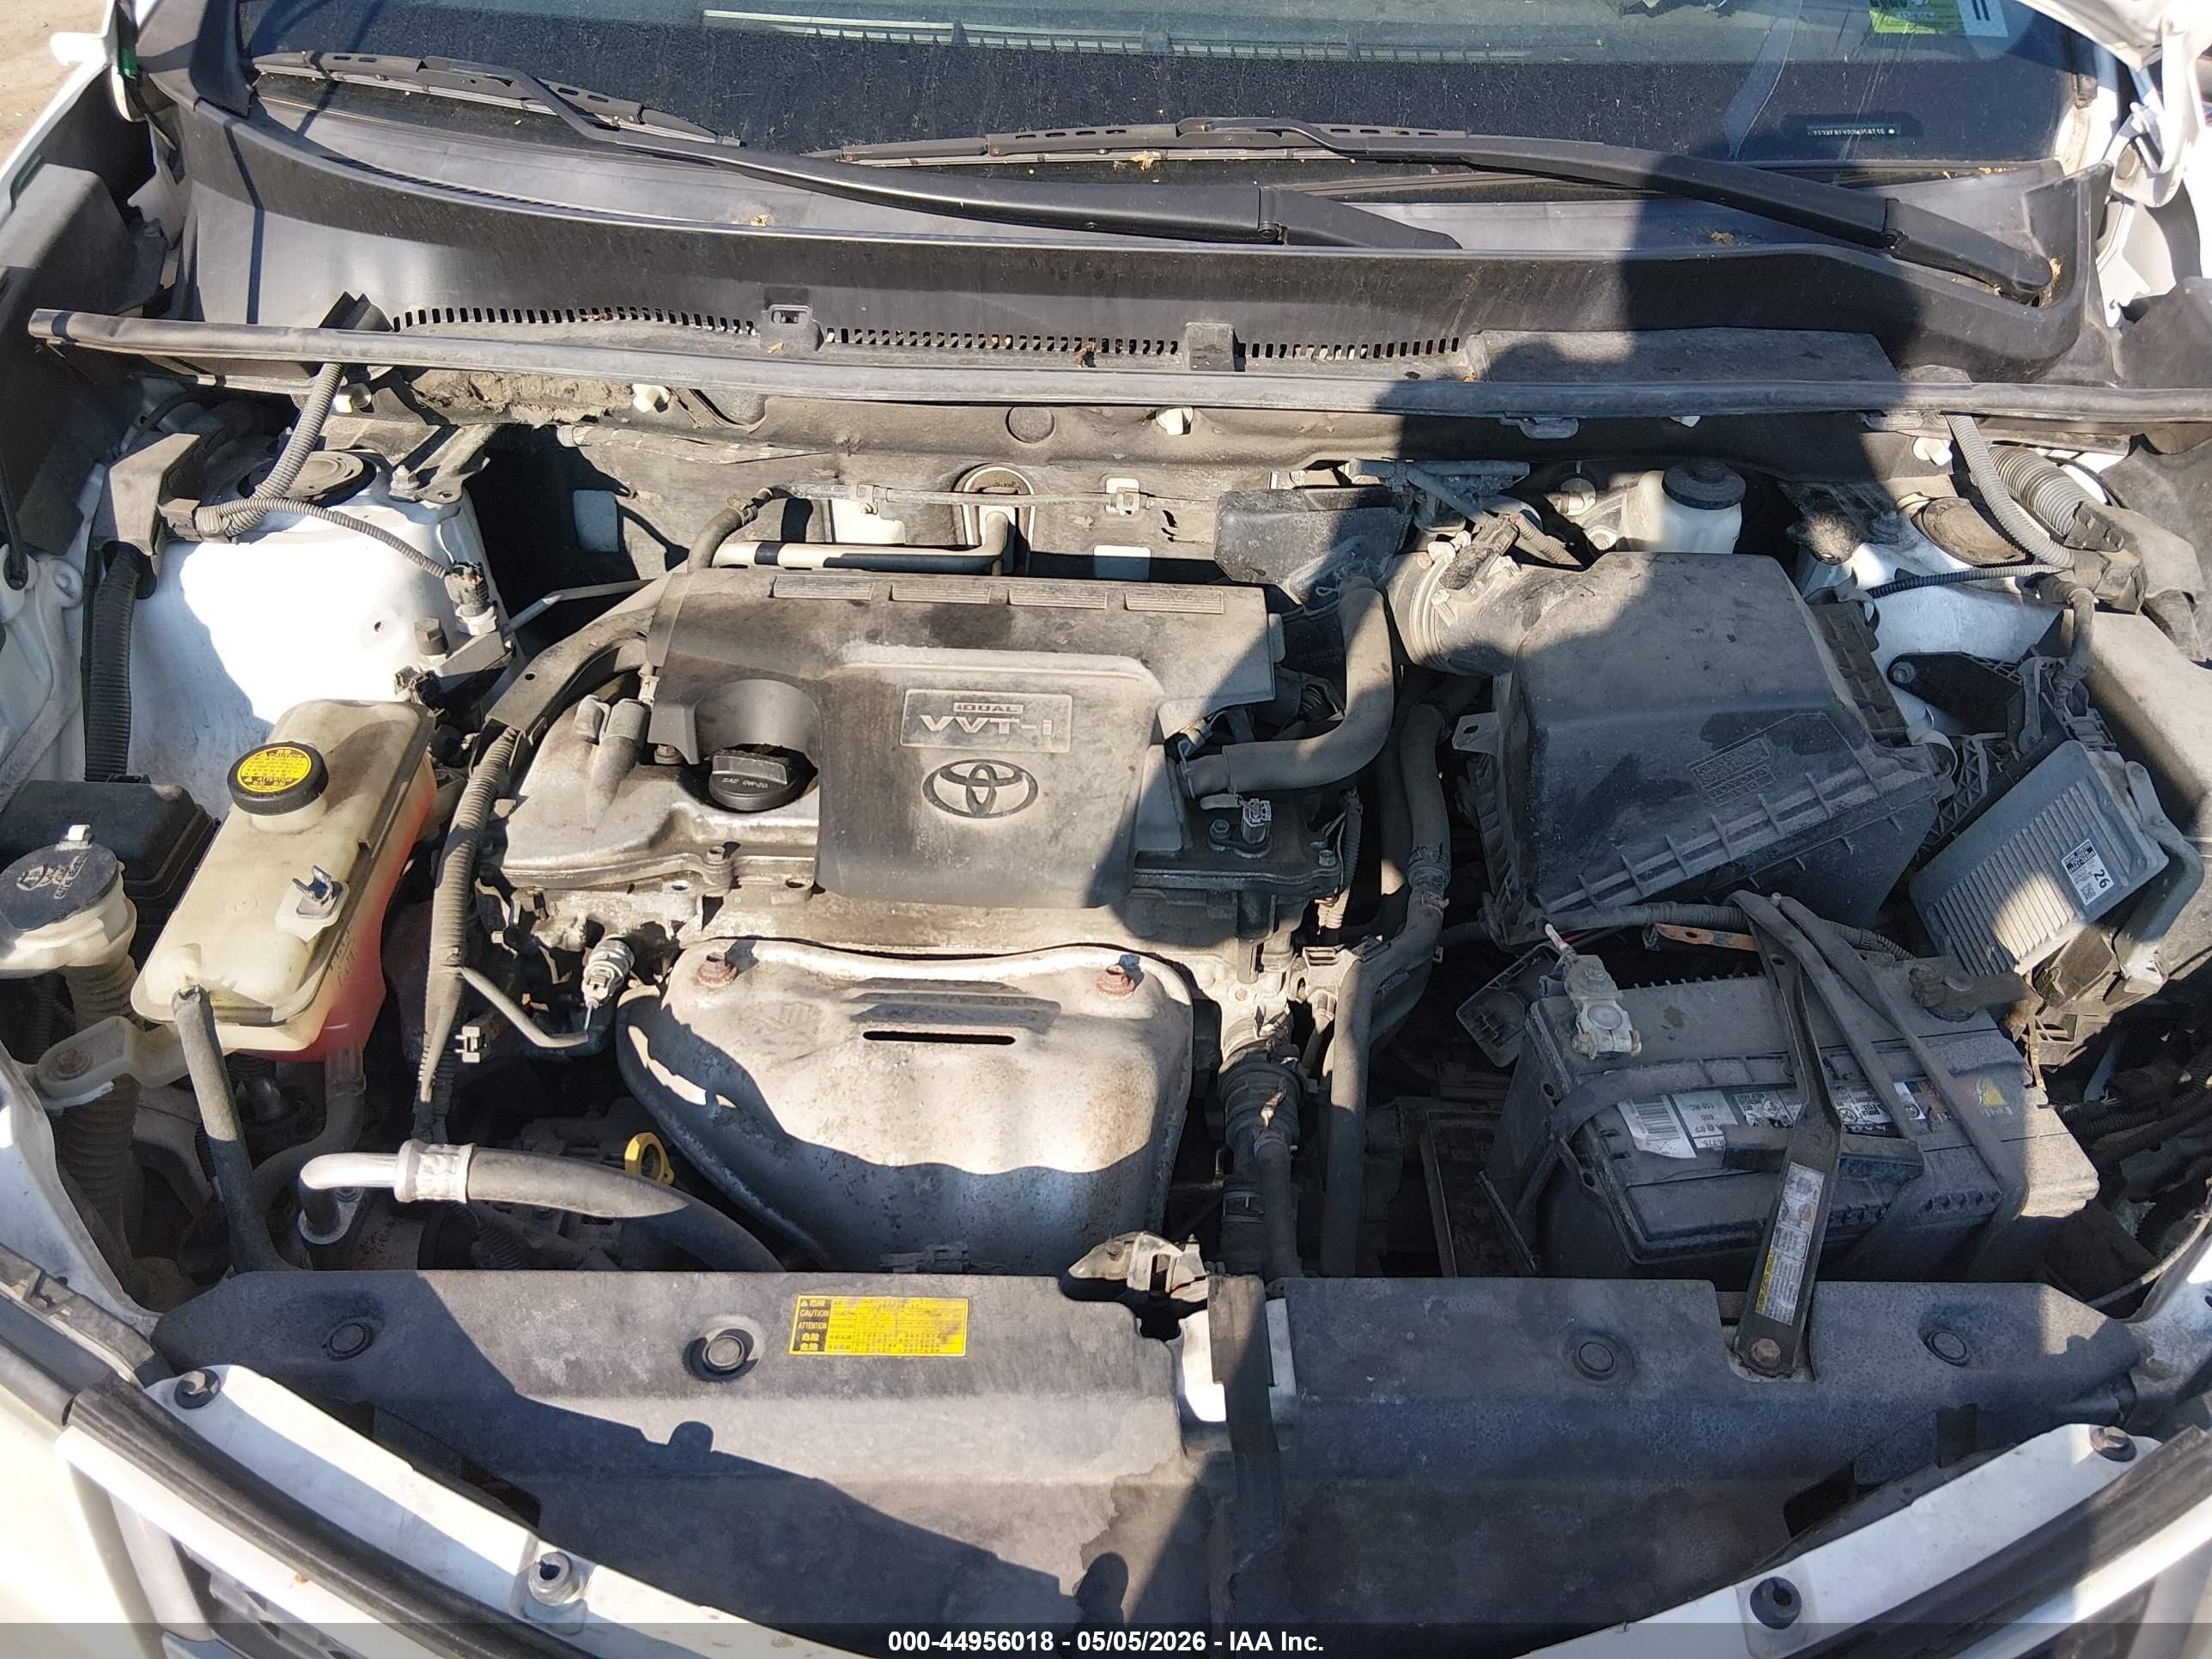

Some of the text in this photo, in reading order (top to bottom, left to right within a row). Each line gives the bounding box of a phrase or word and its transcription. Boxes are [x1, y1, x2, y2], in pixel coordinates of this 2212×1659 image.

[961, 703, 1019, 713] DUAL
[920, 714, 1053, 736] VVT-i
[742, 779, 769, 789] 0W-20
[2070, 851, 2088, 865] TOYOTA
[2094, 868, 2111, 889] 26
[799, 1309, 830, 1317] CAUTION
